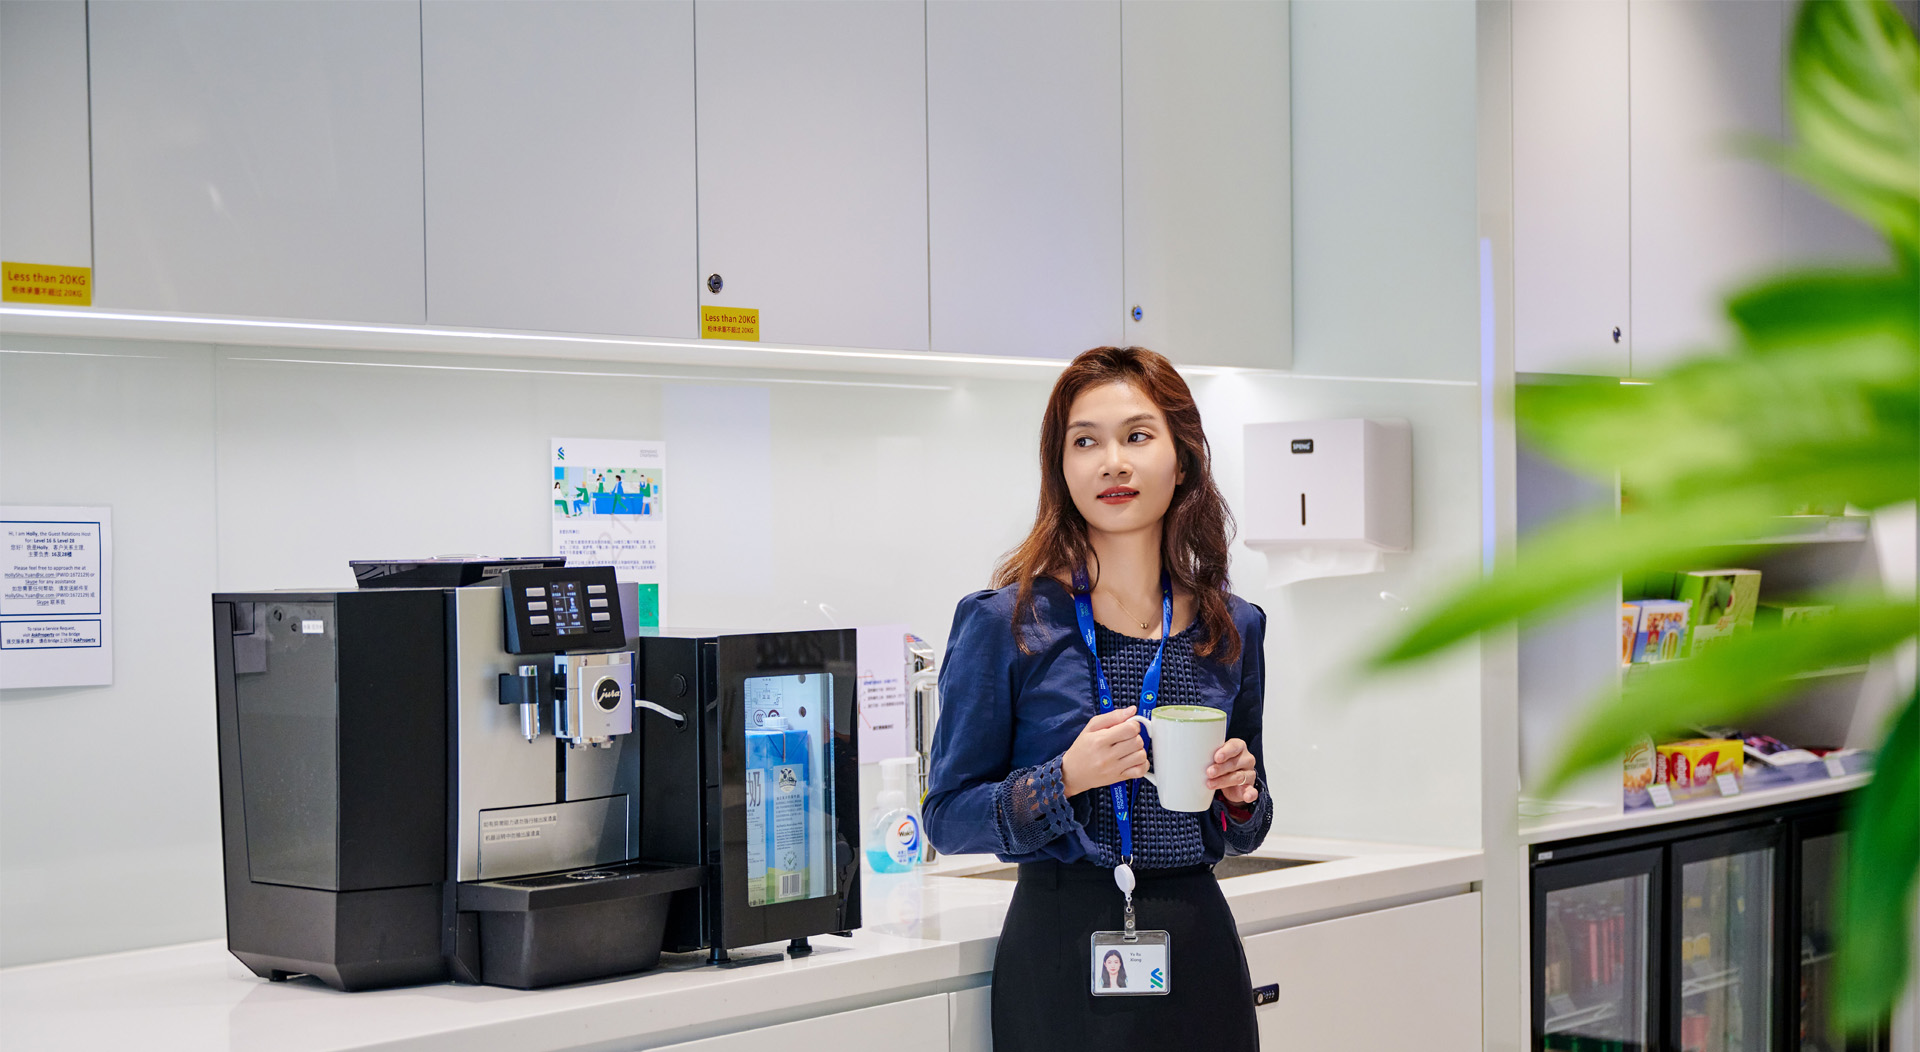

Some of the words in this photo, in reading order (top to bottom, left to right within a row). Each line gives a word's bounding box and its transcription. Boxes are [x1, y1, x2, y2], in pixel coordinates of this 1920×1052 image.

[8, 270, 30, 281] Less
[33, 273, 56, 283] than
[59, 274, 85, 285] 20KG
[705, 314, 720, 322] Less
[722, 314, 737, 323] than
[739, 315, 756, 324] 20KG
[598, 688, 620, 703] jura
